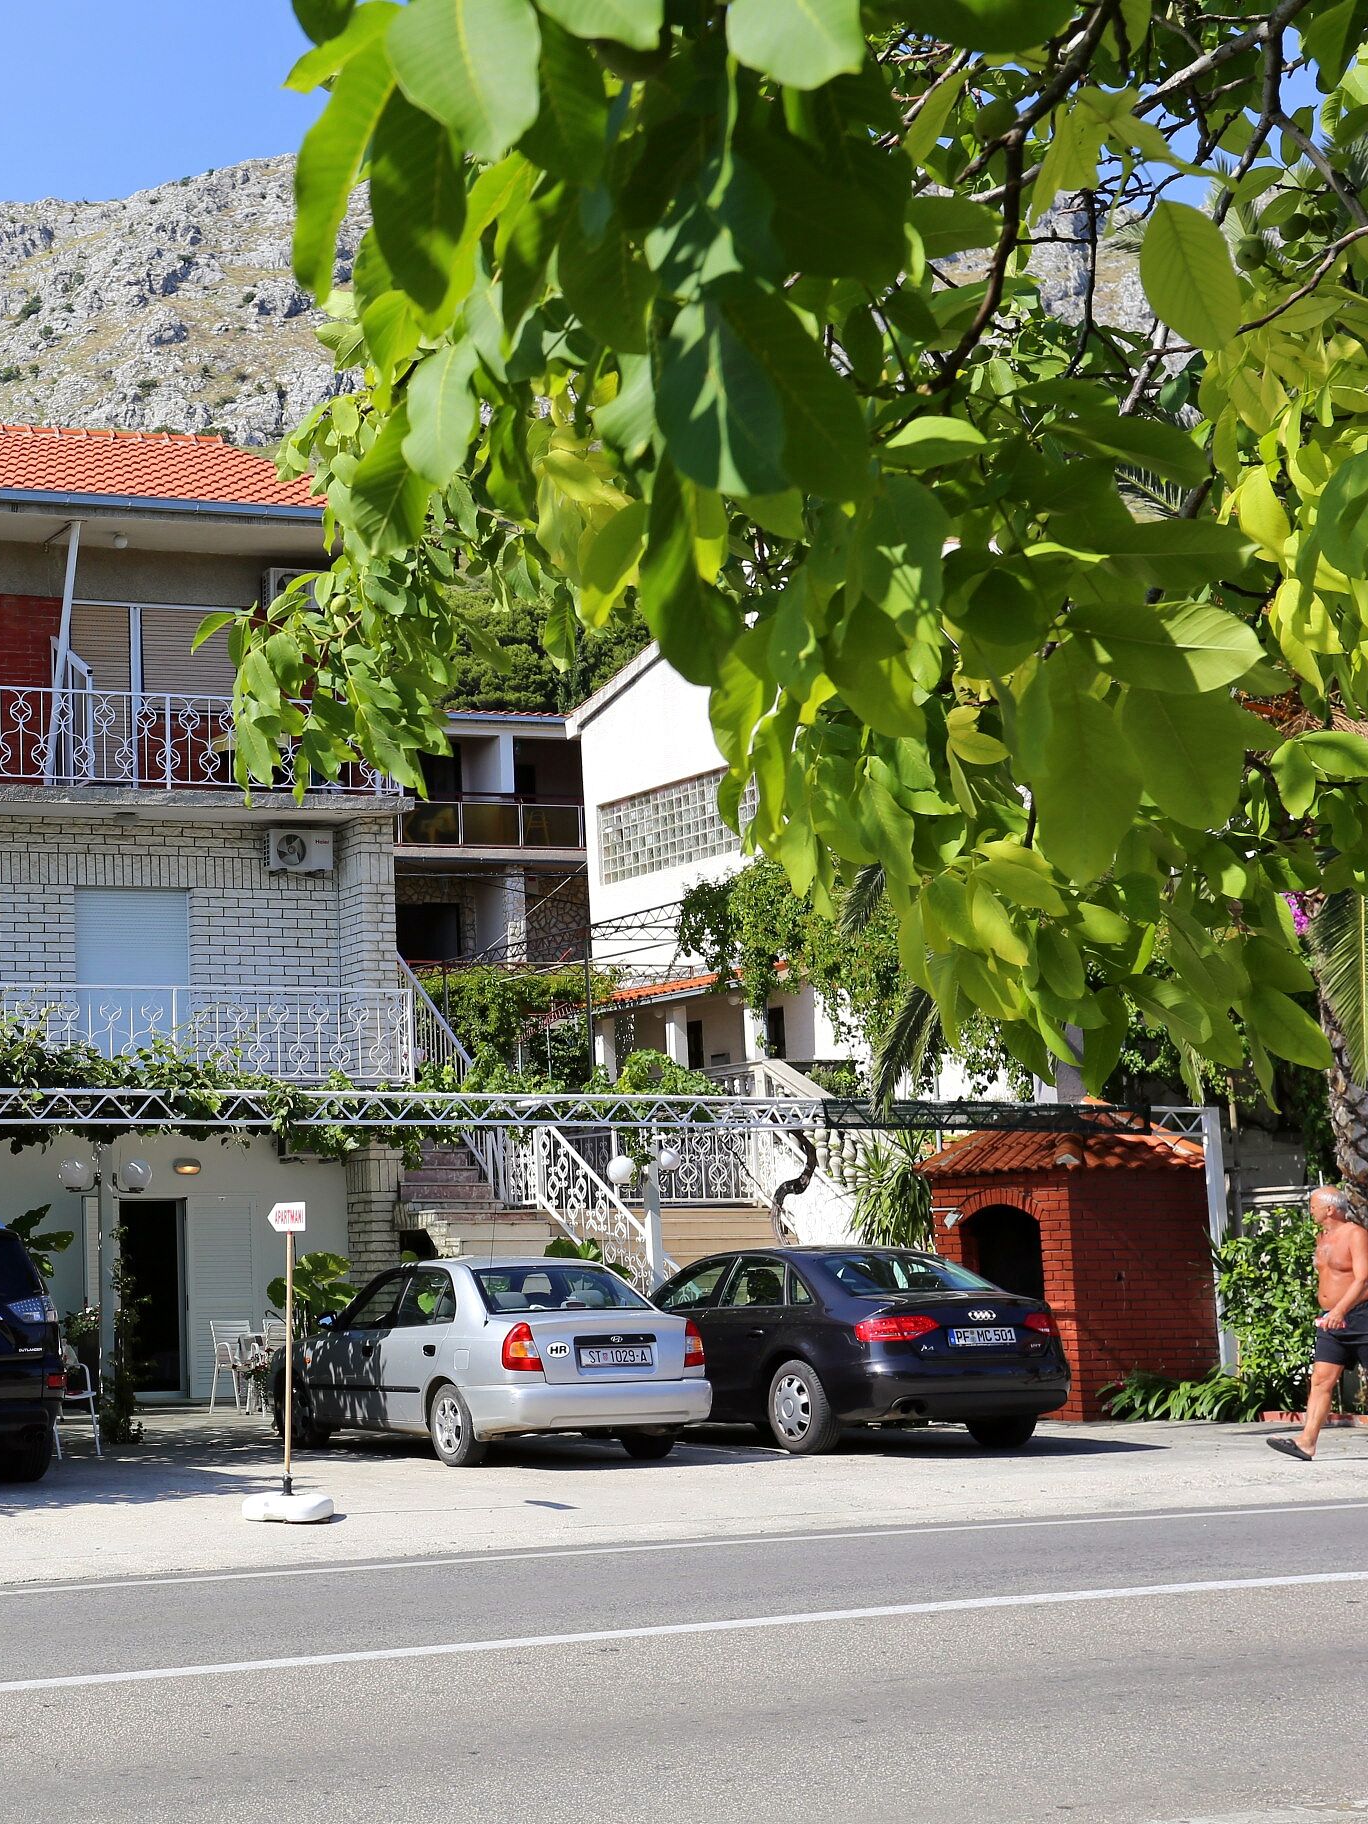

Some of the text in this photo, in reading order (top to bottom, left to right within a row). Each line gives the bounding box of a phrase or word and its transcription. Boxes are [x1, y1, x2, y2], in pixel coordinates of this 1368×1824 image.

[274, 1209, 304, 1224] APARTMANI
[955, 1329, 1015, 1343] PF MC 501
[549, 1345, 567, 1355] HR
[588, 1349, 648, 1363] ST 1029-A
